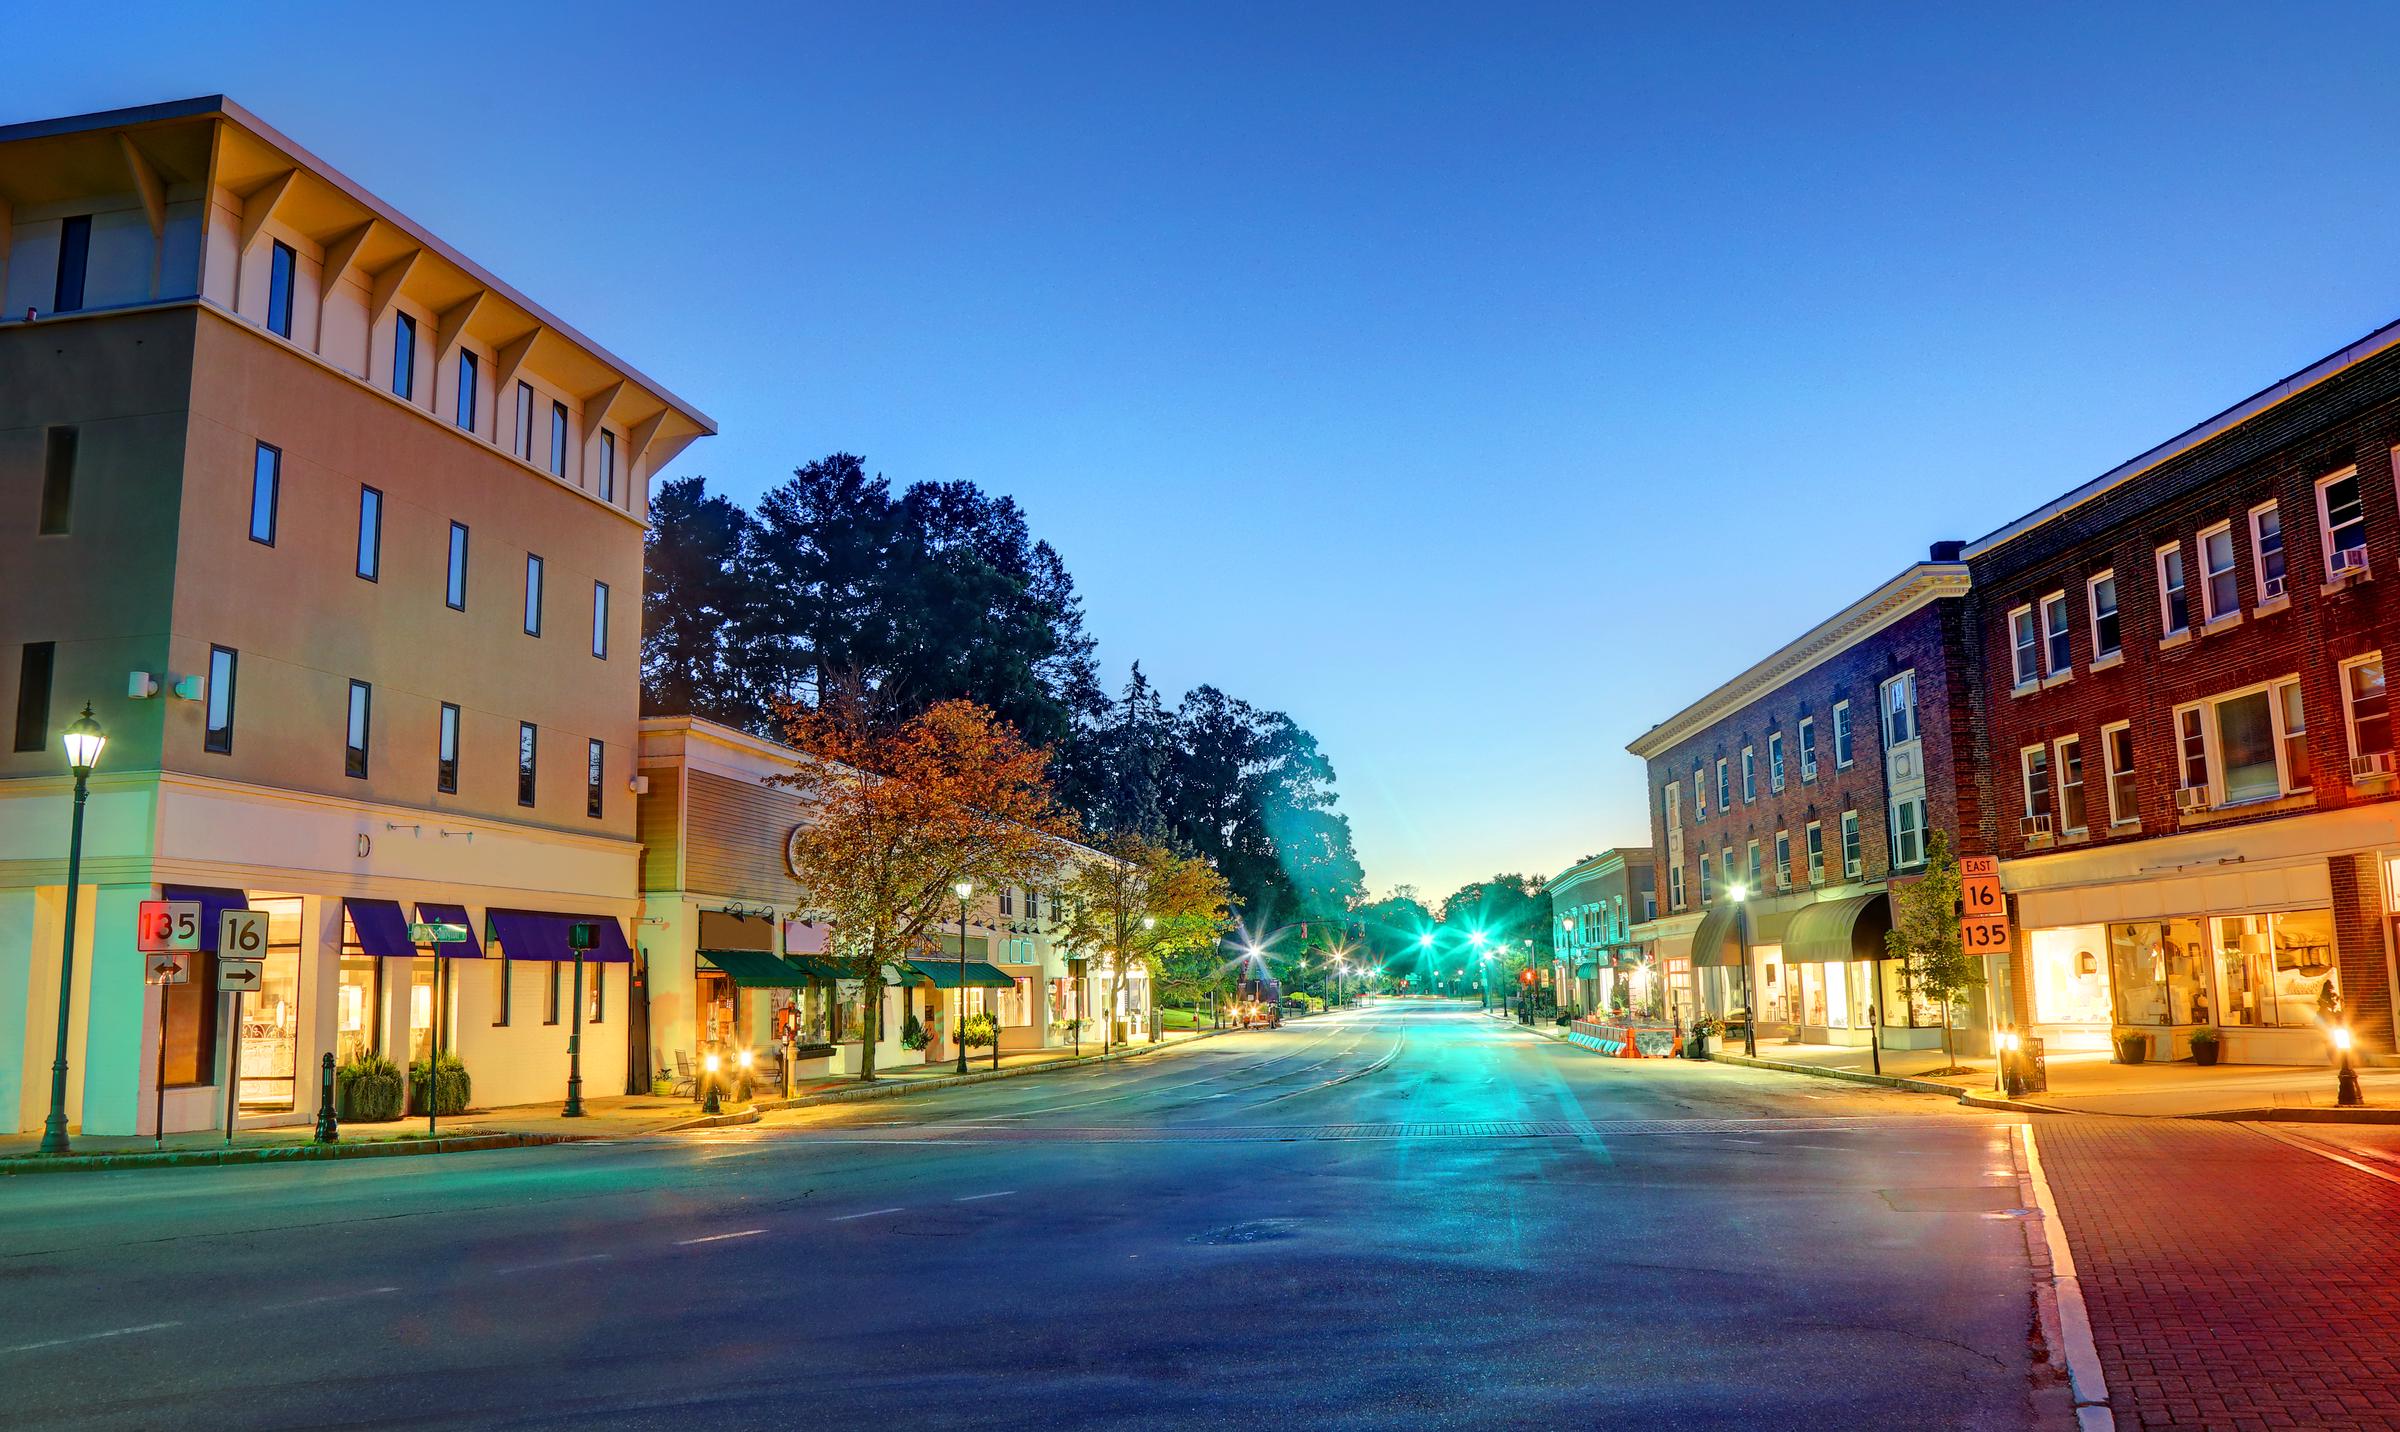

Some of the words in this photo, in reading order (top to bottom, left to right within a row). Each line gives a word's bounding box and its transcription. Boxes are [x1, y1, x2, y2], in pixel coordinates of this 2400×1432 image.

[1966, 860, 1991, 872] EAST
[1970, 885, 1994, 906] 16
[143, 913, 195, 940] 135
[228, 918, 260, 951] 16
[1965, 924, 2006, 947] 135
